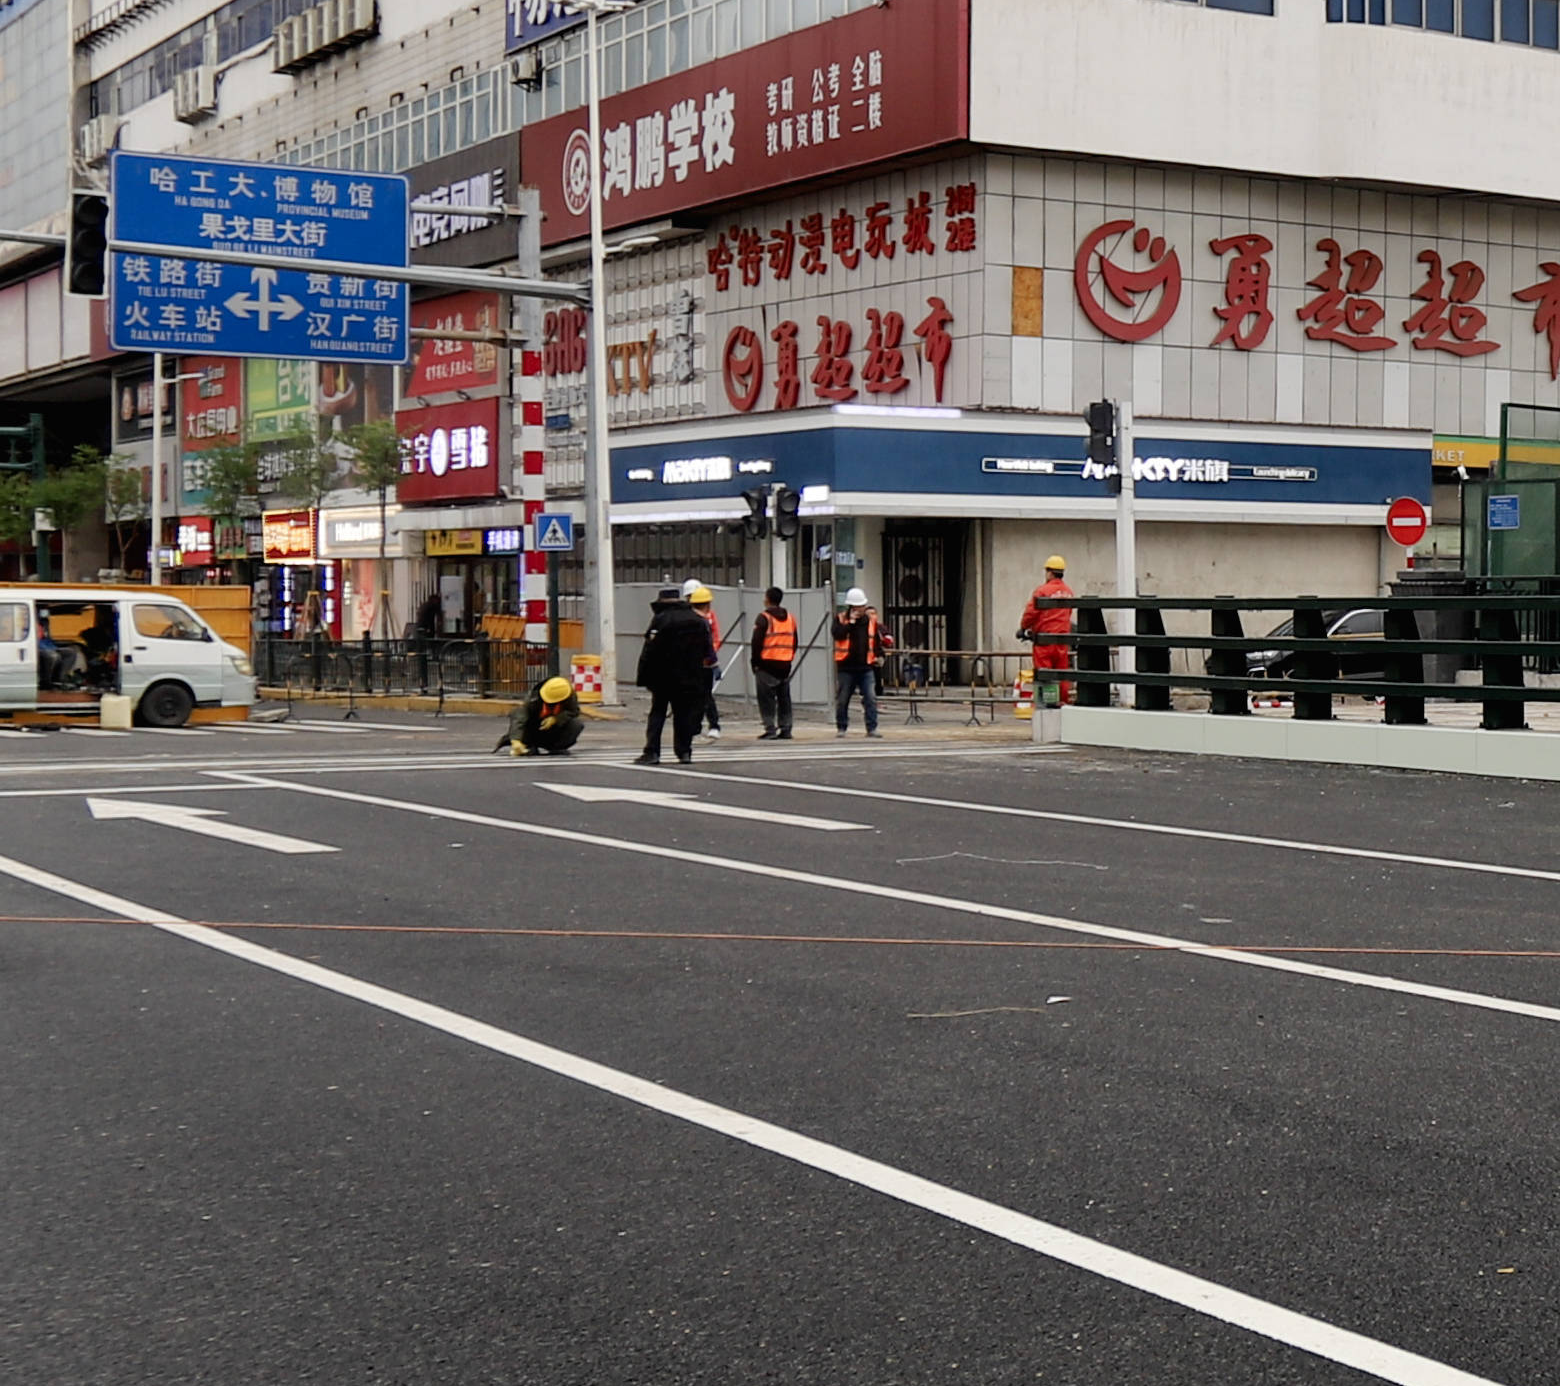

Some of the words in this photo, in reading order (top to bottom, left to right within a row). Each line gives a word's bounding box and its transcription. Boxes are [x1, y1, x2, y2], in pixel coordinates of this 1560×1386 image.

[766, 76, 794, 116] 考研
[812, 62, 840, 104] 公考
[851, 50, 883, 92] 全脑
[766, 104, 840, 157] 教师资格证
[851, 92, 883, 133] 二楼
[603, 87, 736, 201] 鸿鹏学校
[174, 195, 188, 206] HA
[217, 197, 231, 210] DA
[276, 203, 330, 218] PROVINCIAL
[332, 207, 369, 220] MUSEUM
[199, 213, 328, 248] 果戈里大街
[707, 191, 936, 292] 哈特动漫电玩城
[122, 256, 223, 288] 铁路街
[137, 286, 152, 297] TIE
[154, 287, 169, 298] LU
[171, 287, 207, 300] STREET
[353, 298, 387, 312] STREET
[123, 301, 223, 332] 火车站
[306, 312, 400, 342] 汉广街
[130, 329, 172, 342] RAILWAY
[174, 330, 215, 344] STATION
[771, 296, 953, 410] 勇超超市
